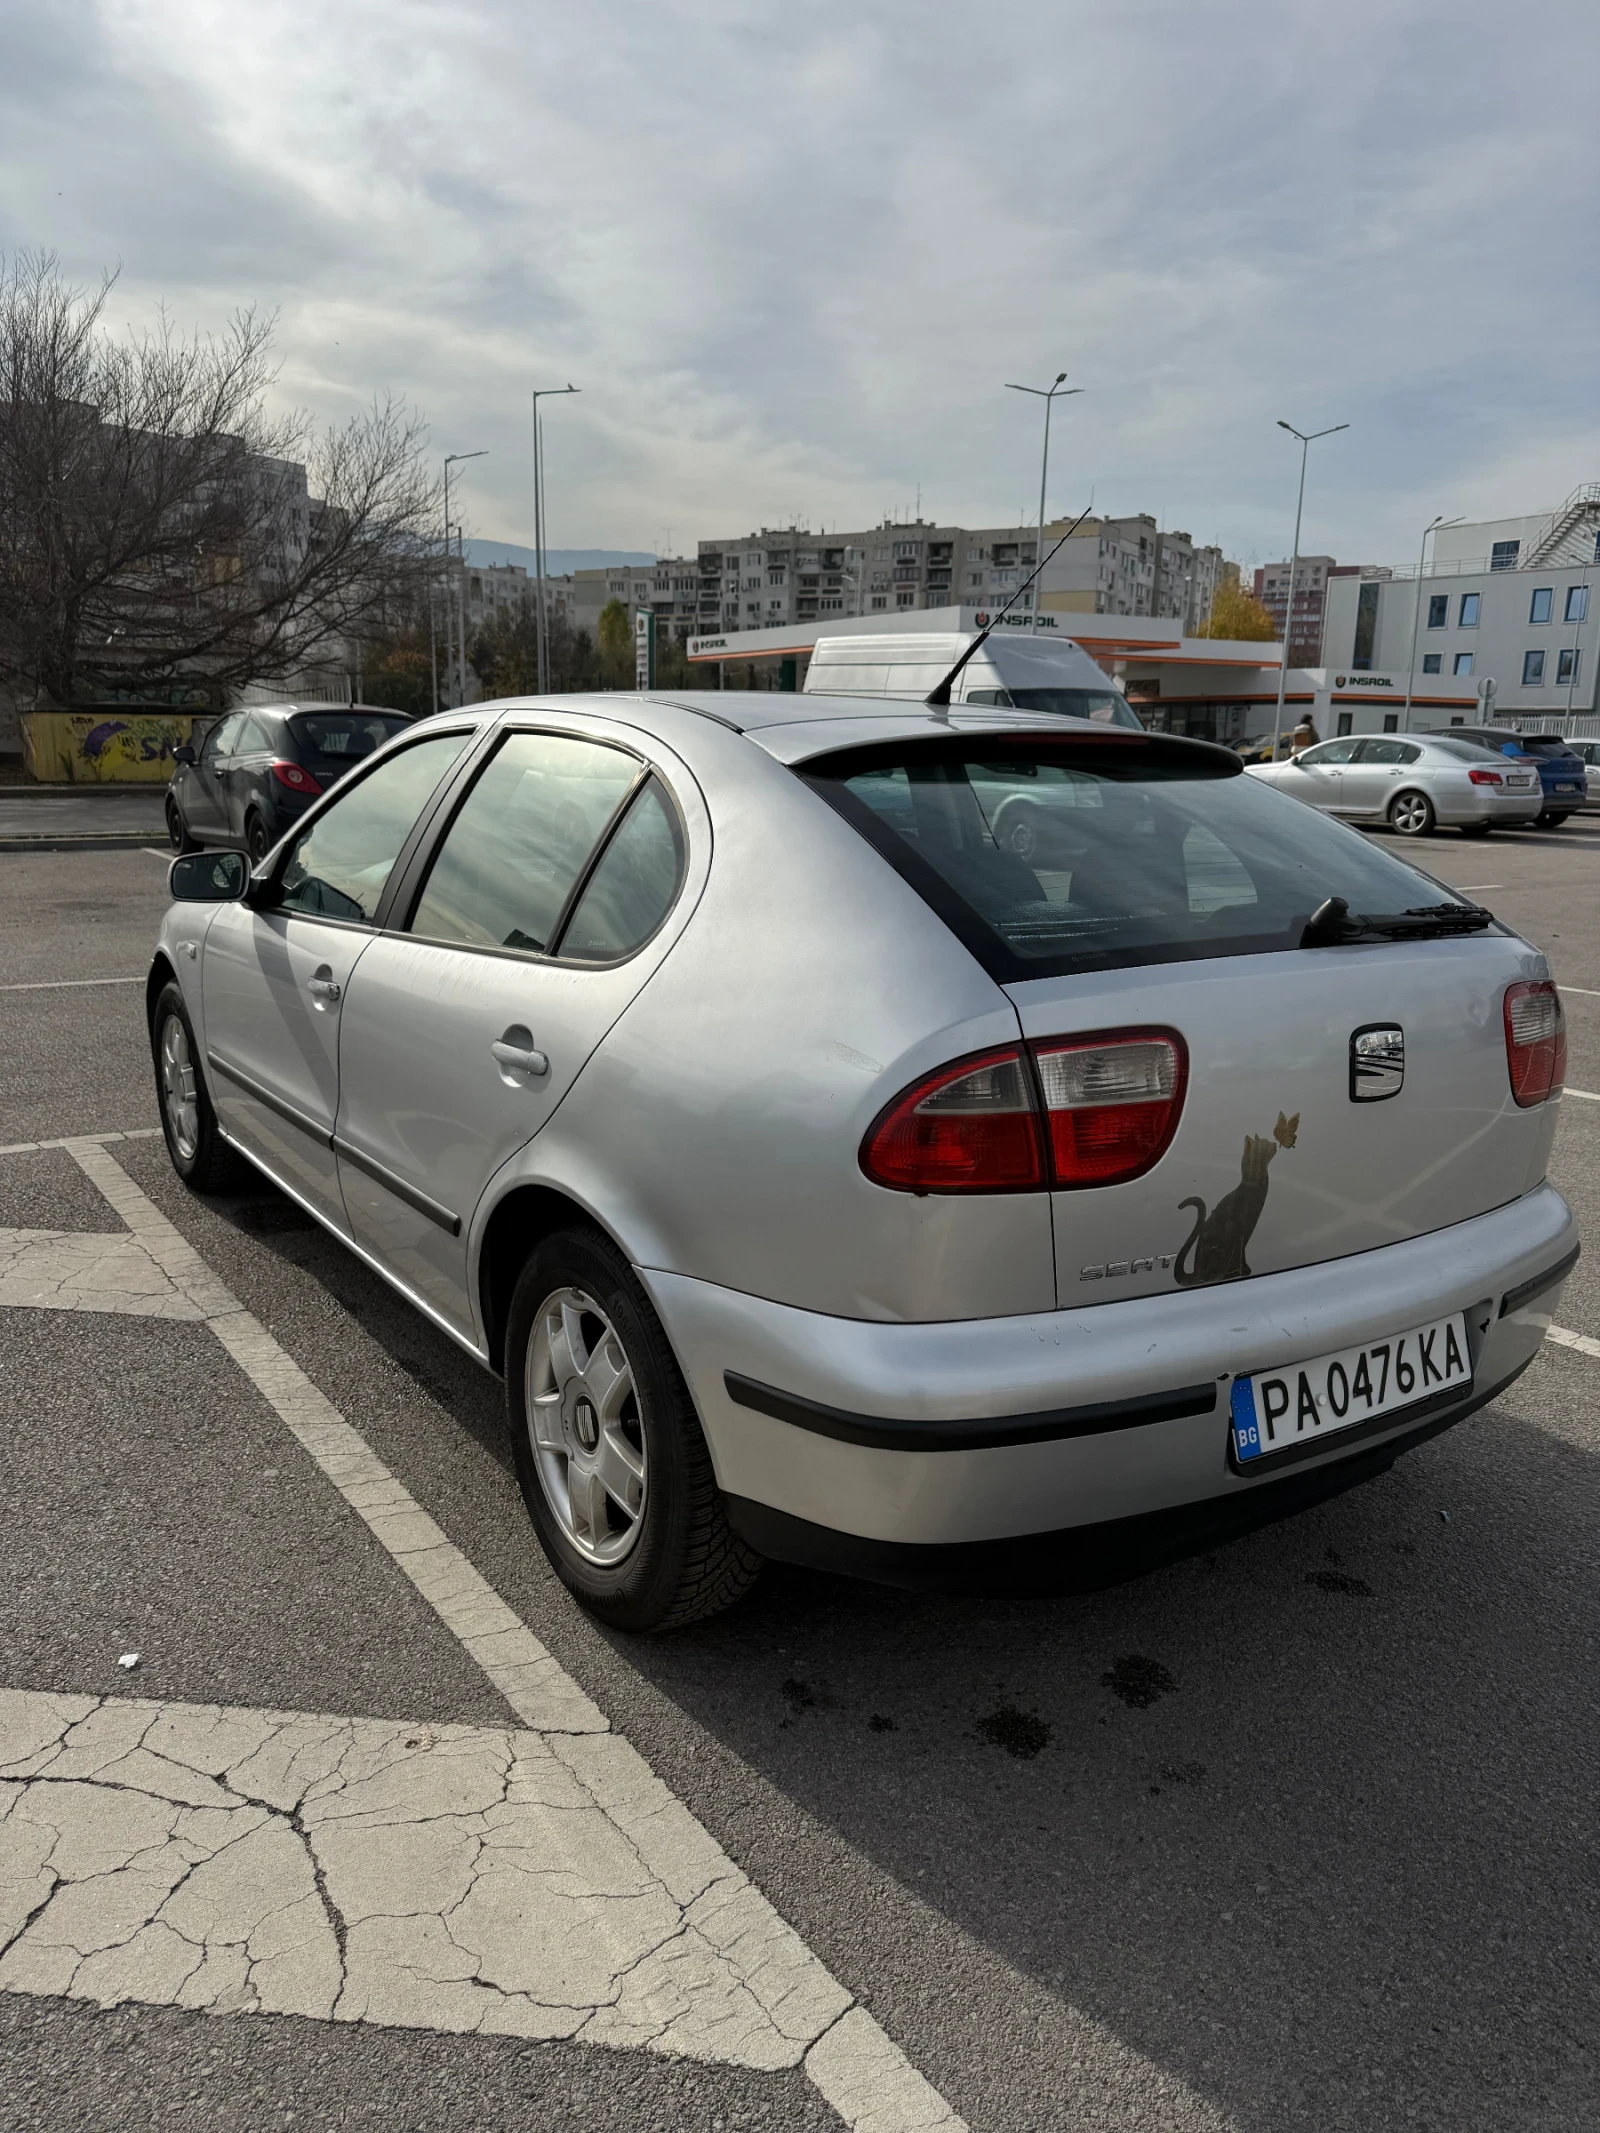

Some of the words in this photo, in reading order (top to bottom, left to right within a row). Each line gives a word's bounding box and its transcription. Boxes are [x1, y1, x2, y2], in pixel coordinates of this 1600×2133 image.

[1349, 676, 1394, 687] INSAOIL
[1080, 1252, 1178, 1282] SEAT
[1238, 1426, 1258, 1448] BG
